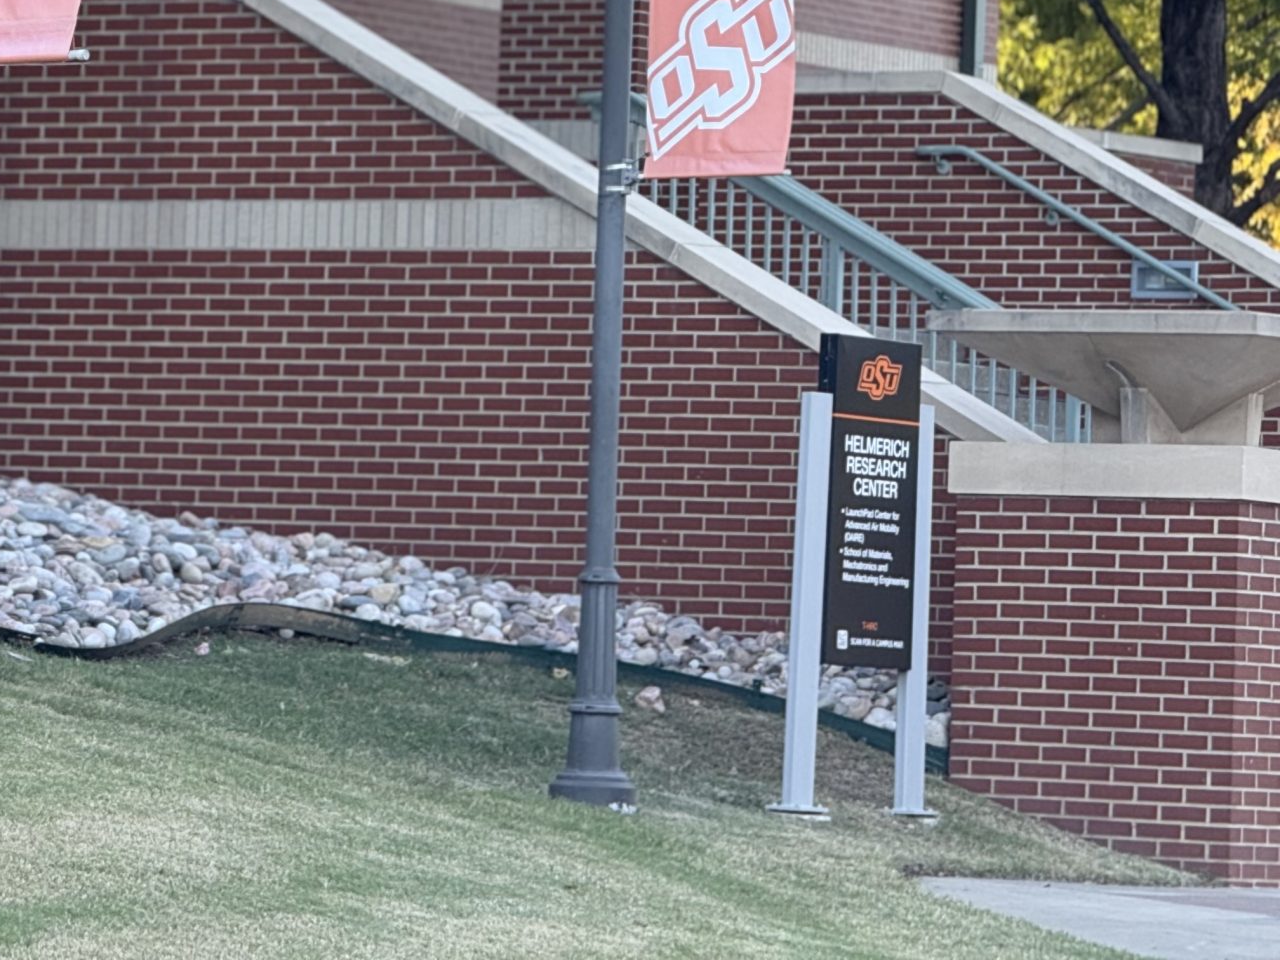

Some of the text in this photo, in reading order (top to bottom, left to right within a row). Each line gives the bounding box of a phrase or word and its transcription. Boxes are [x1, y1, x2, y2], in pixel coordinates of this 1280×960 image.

[857, 355, 903, 400] OSU
[844, 434, 910, 458] HELMERICH
[846, 456, 907, 479] RESEARCH
[853, 478, 898, 499] CENTER
[874, 509, 891, 520] Center
[844, 520, 870, 531] Advanced
[843, 546, 861, 557] School
